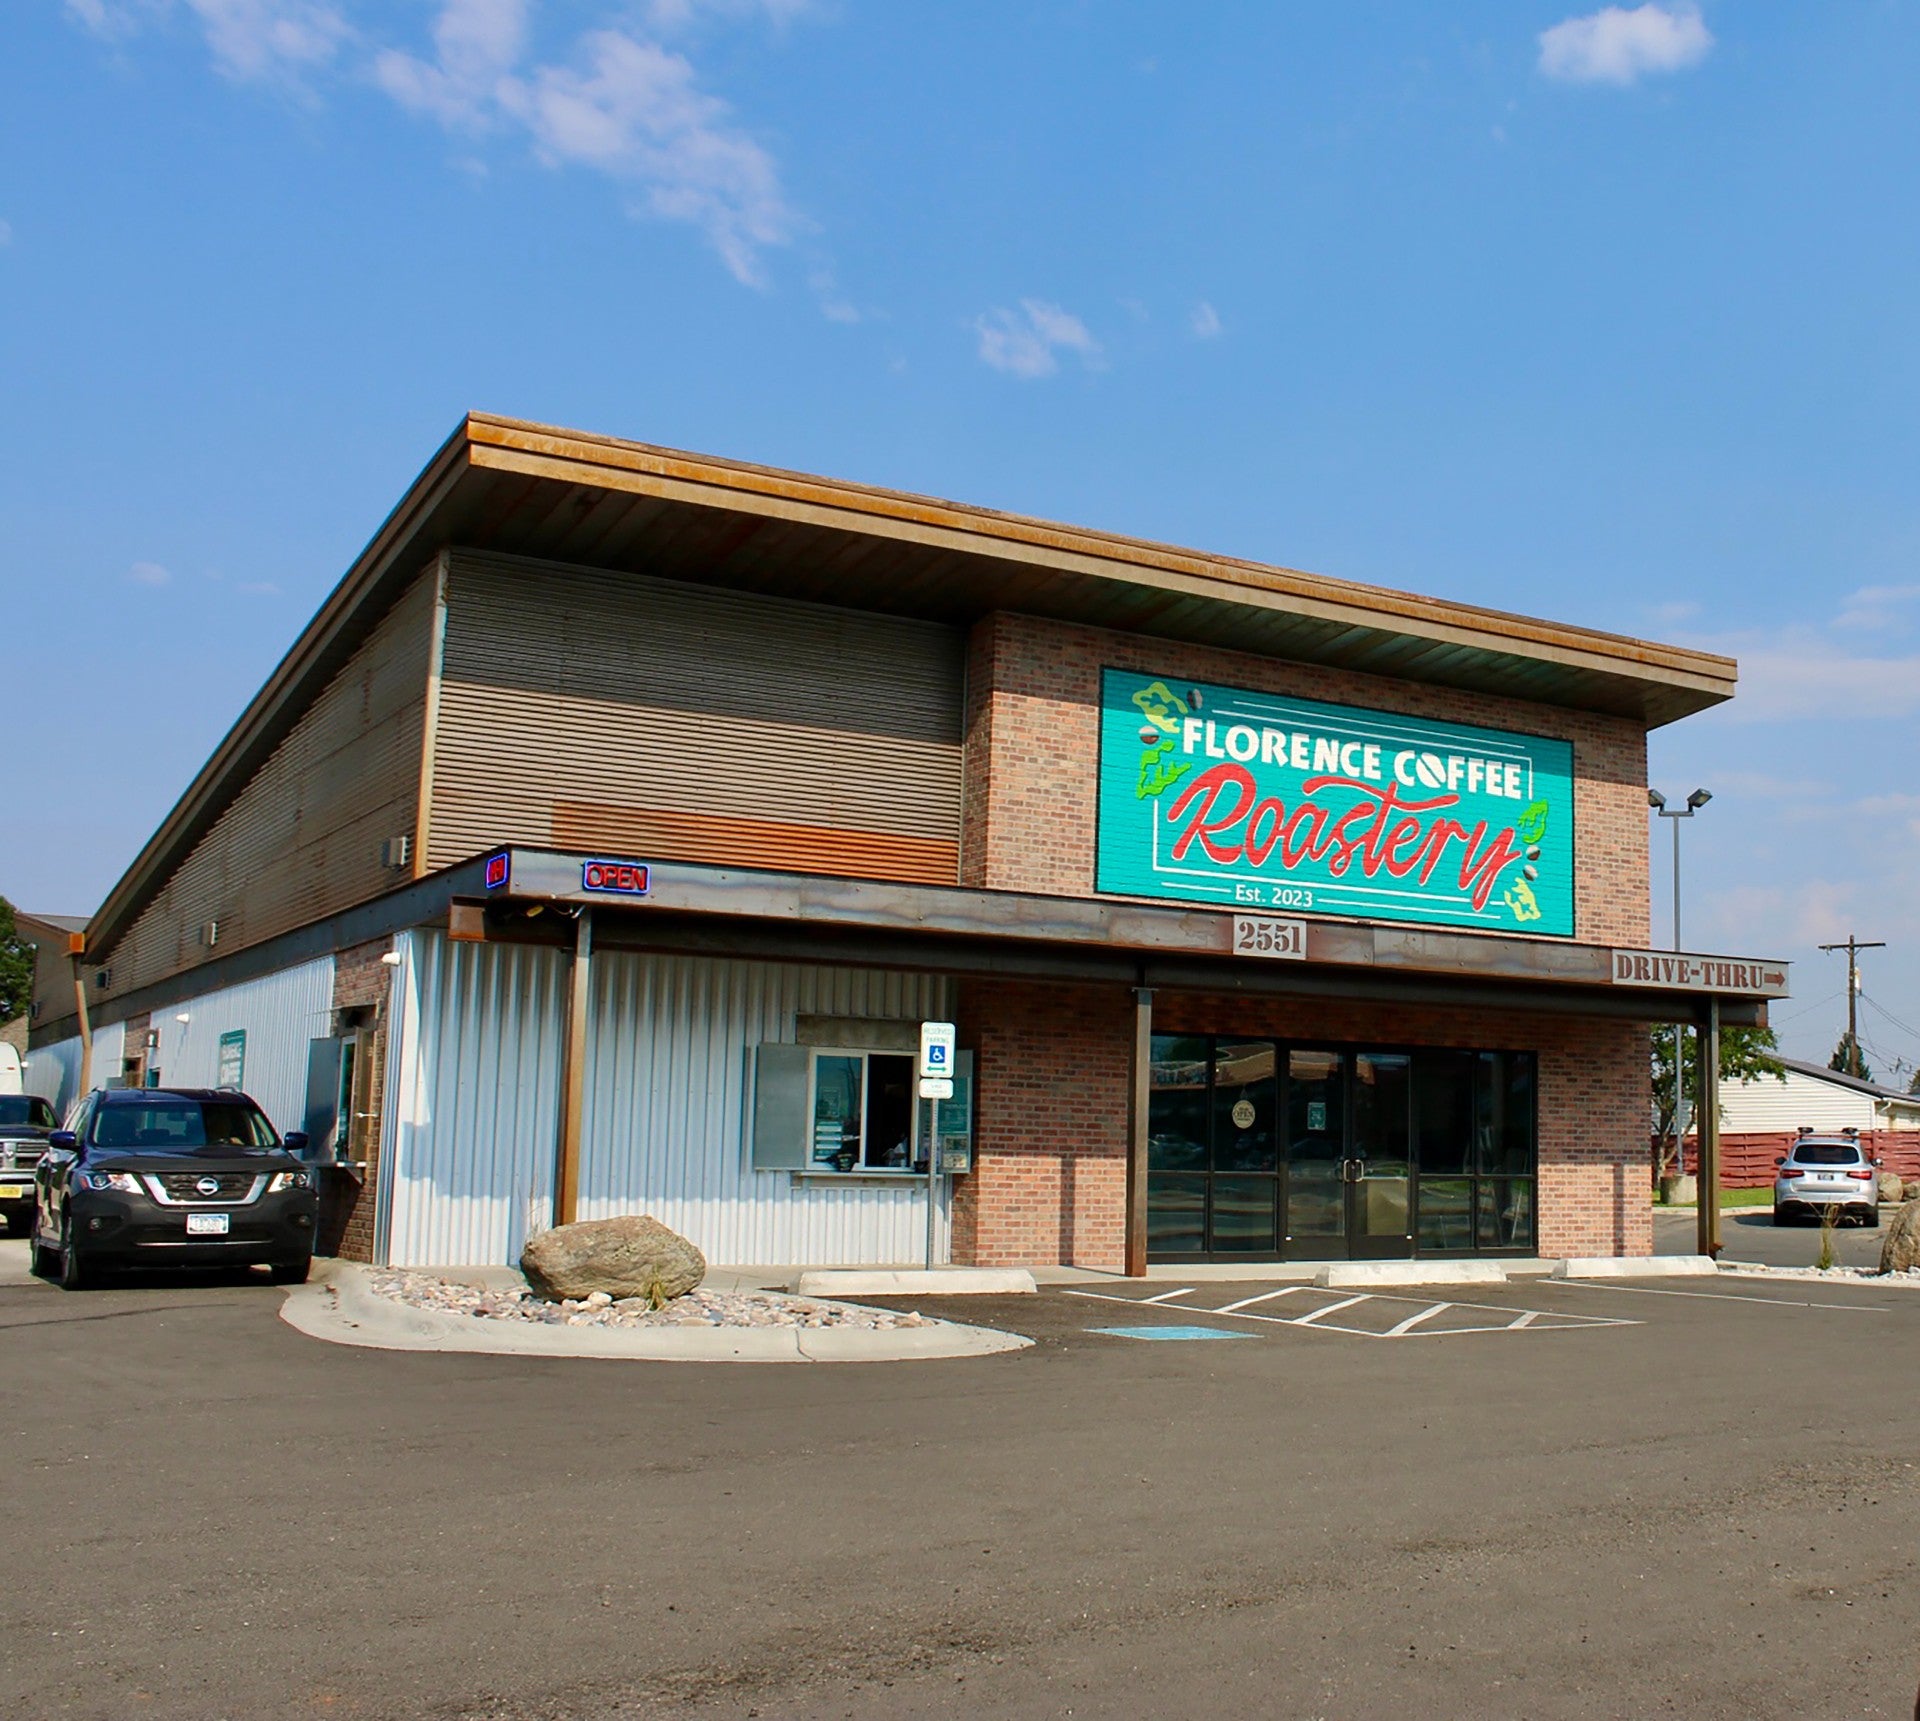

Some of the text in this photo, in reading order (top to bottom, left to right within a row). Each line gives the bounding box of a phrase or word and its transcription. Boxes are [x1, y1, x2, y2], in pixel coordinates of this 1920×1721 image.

[1183, 717, 1522, 800] FLORENCE COFFEE
[1167, 762, 1522, 912] Roastery
[587, 864, 646, 890] OPEN
[1235, 883, 1313, 908] Est. 2023
[1238, 921, 1302, 953] 2551
[1616, 954, 1764, 989] DRIVE-THRU
